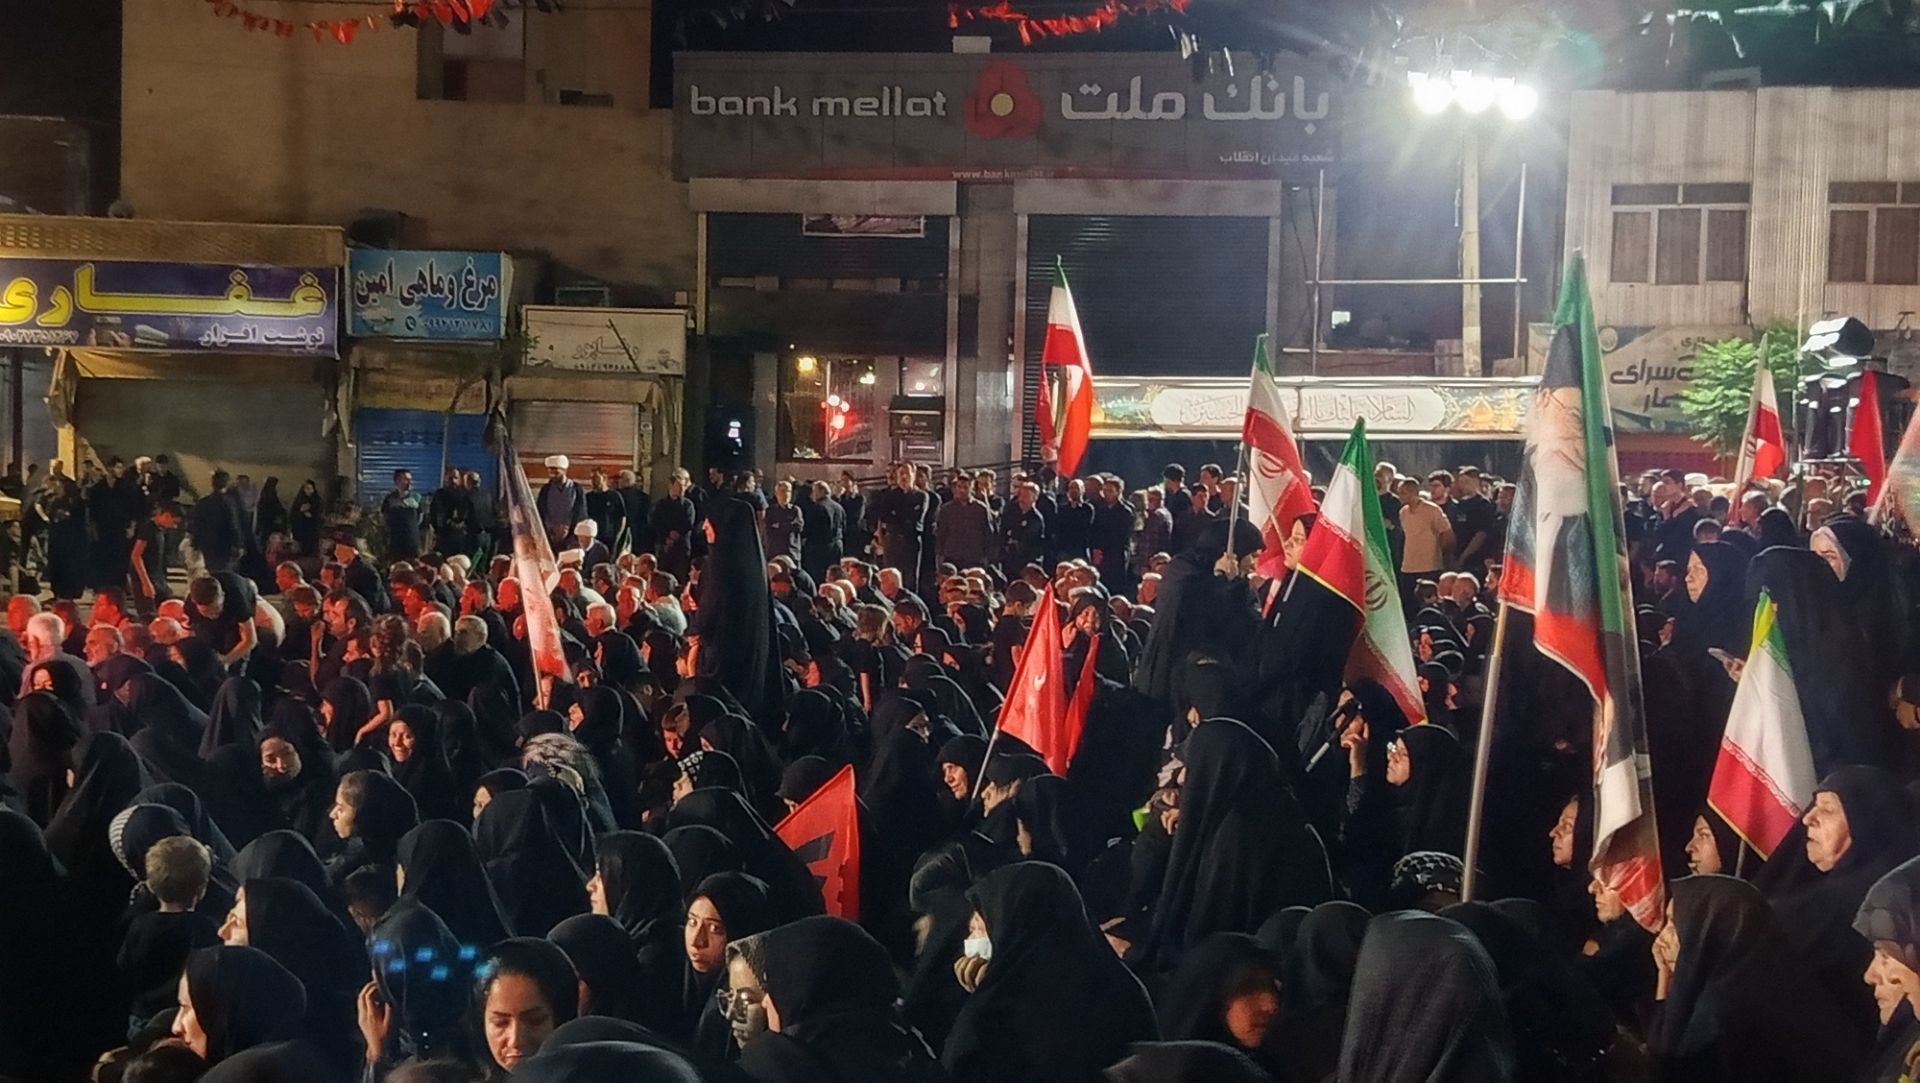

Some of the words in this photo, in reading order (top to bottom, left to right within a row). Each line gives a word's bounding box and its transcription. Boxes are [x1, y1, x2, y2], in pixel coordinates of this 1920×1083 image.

[690, 84, 798, 116] bank
[812, 85, 947, 117] mellat
[1061, 75, 1186, 120] ملت
[1219, 151, 1259, 164] انقلاب
[1261, 152, 1300, 165] میدان
[0, 263, 327, 327] غفاری
[355, 257, 395, 307] امین
[459, 256, 498, 311] مرغ
[199, 322, 258, 347] افزار
[263, 325, 325, 350] نوشت
